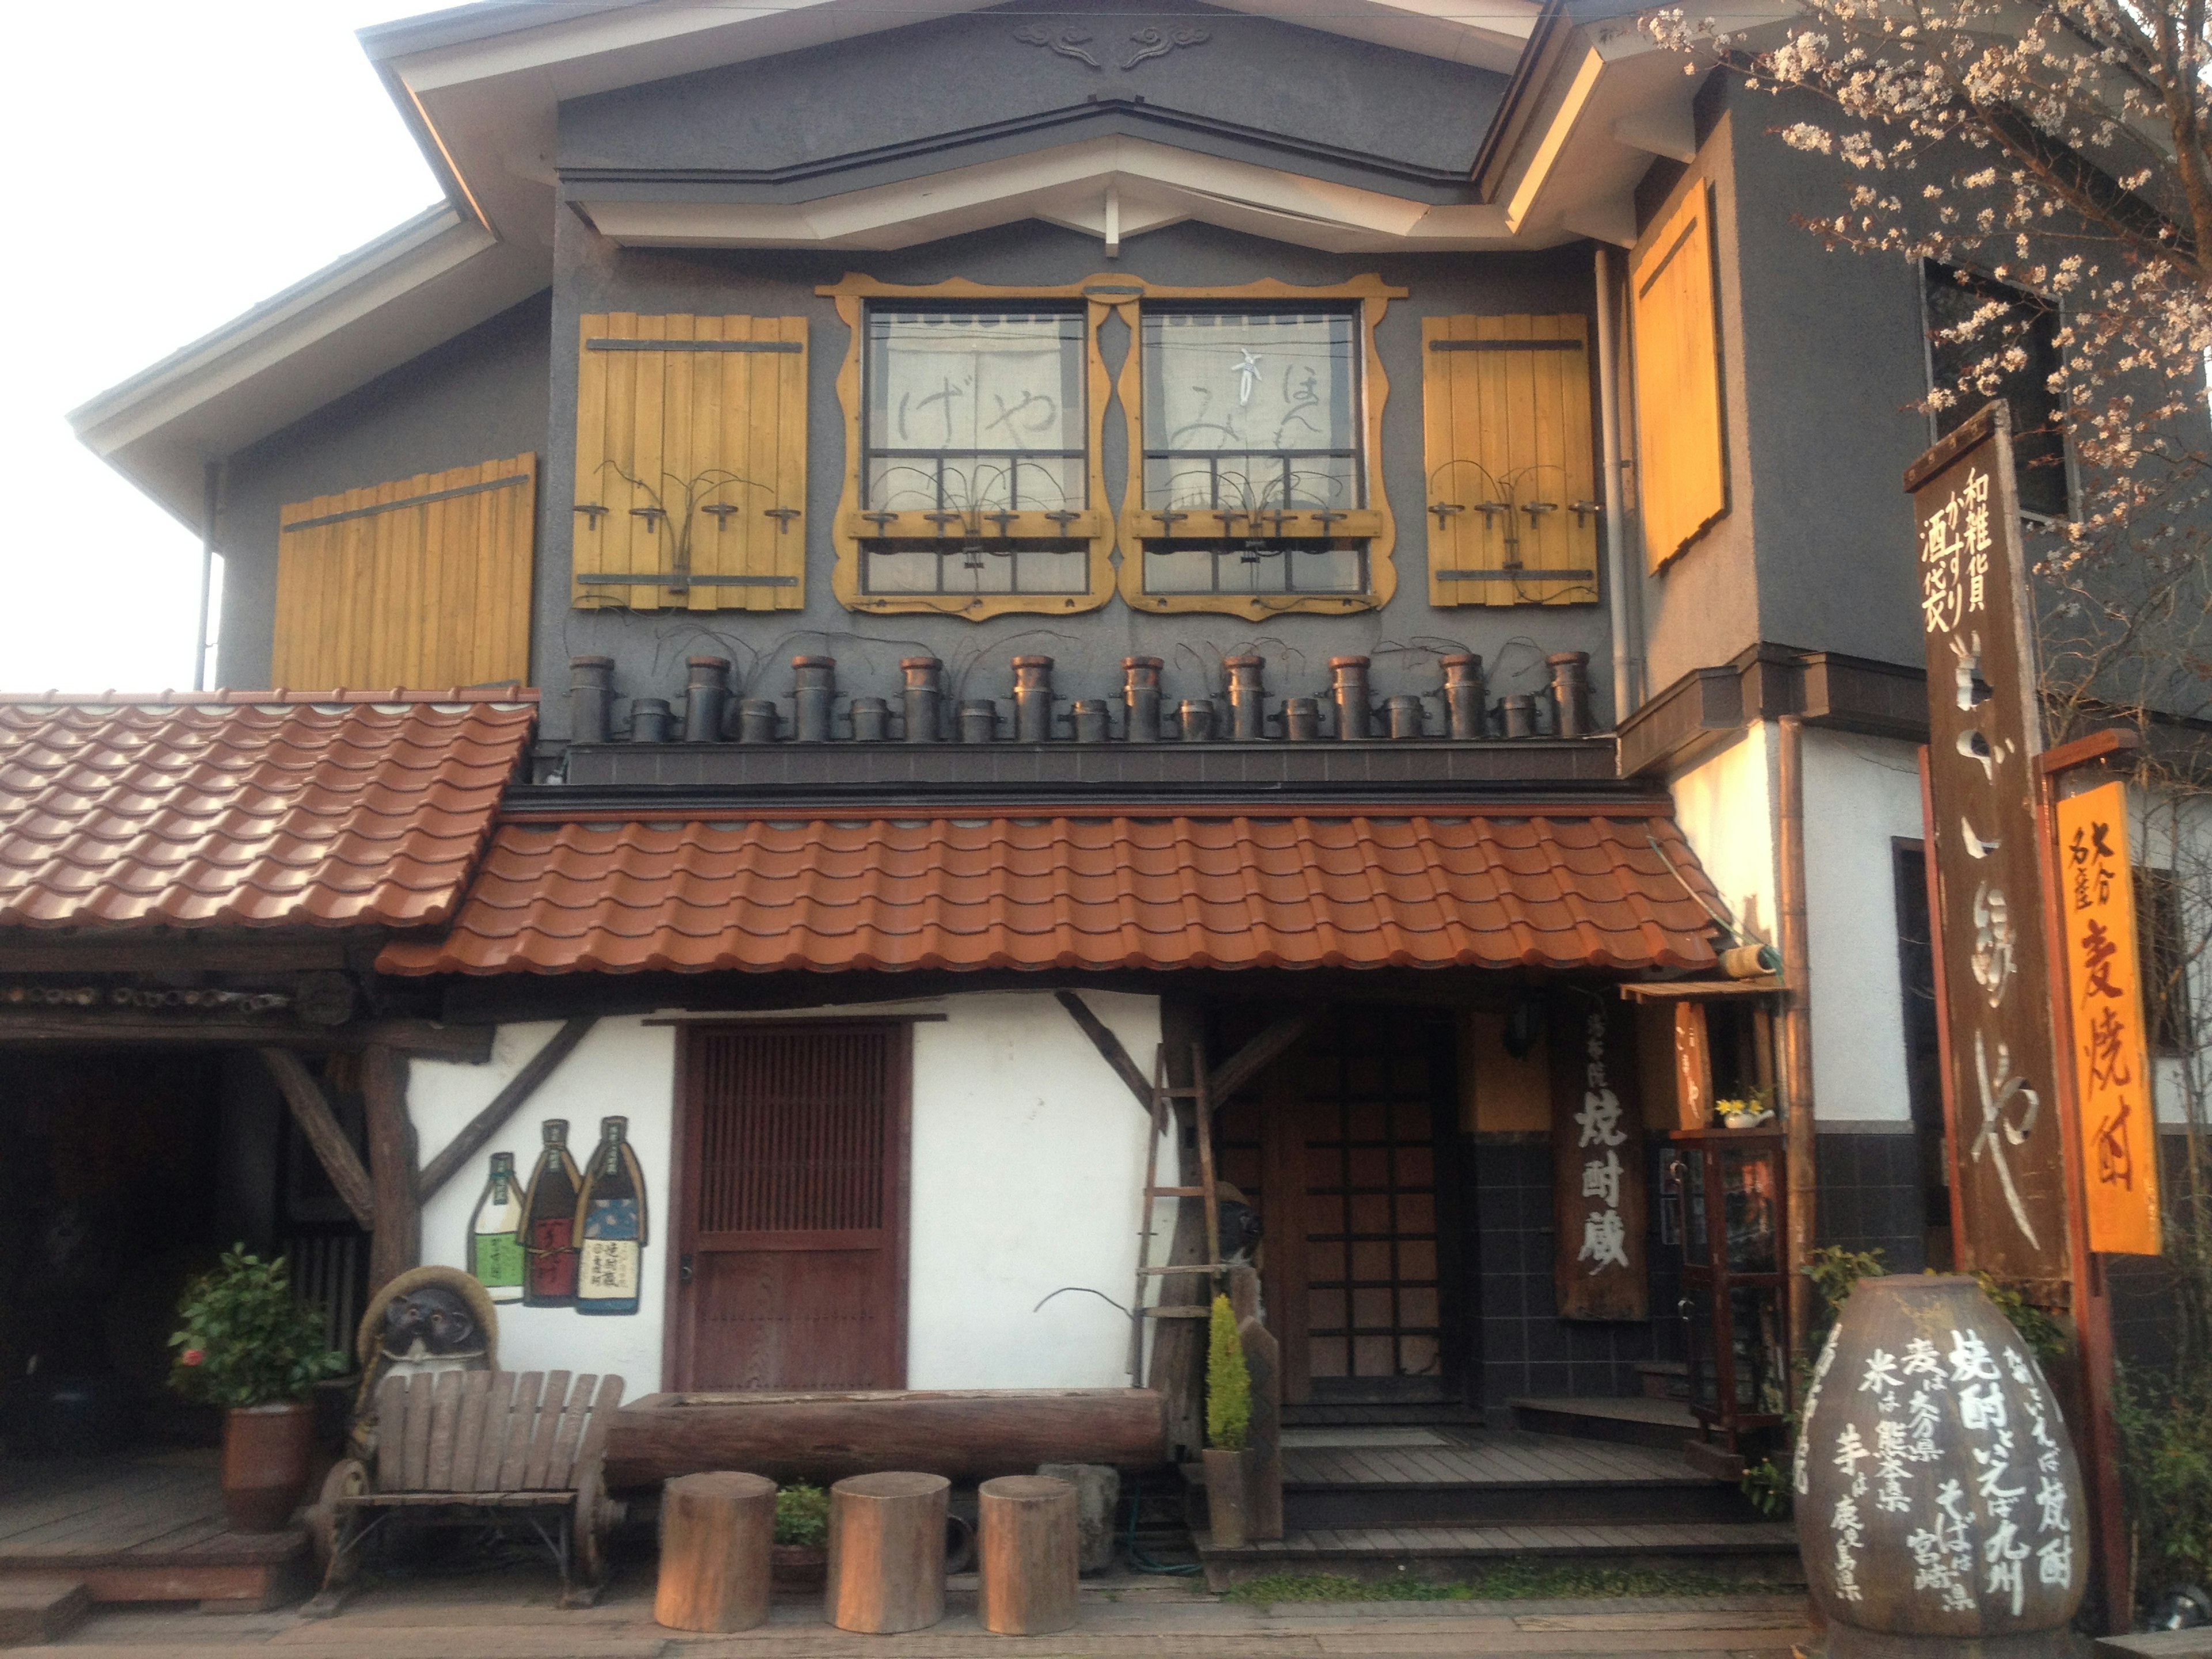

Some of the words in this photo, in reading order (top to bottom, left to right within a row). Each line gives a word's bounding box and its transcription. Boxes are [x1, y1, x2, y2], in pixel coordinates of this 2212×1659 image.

[1944, 491, 1964, 628] かすり
[1963, 467, 1992, 612] 和雑貨
